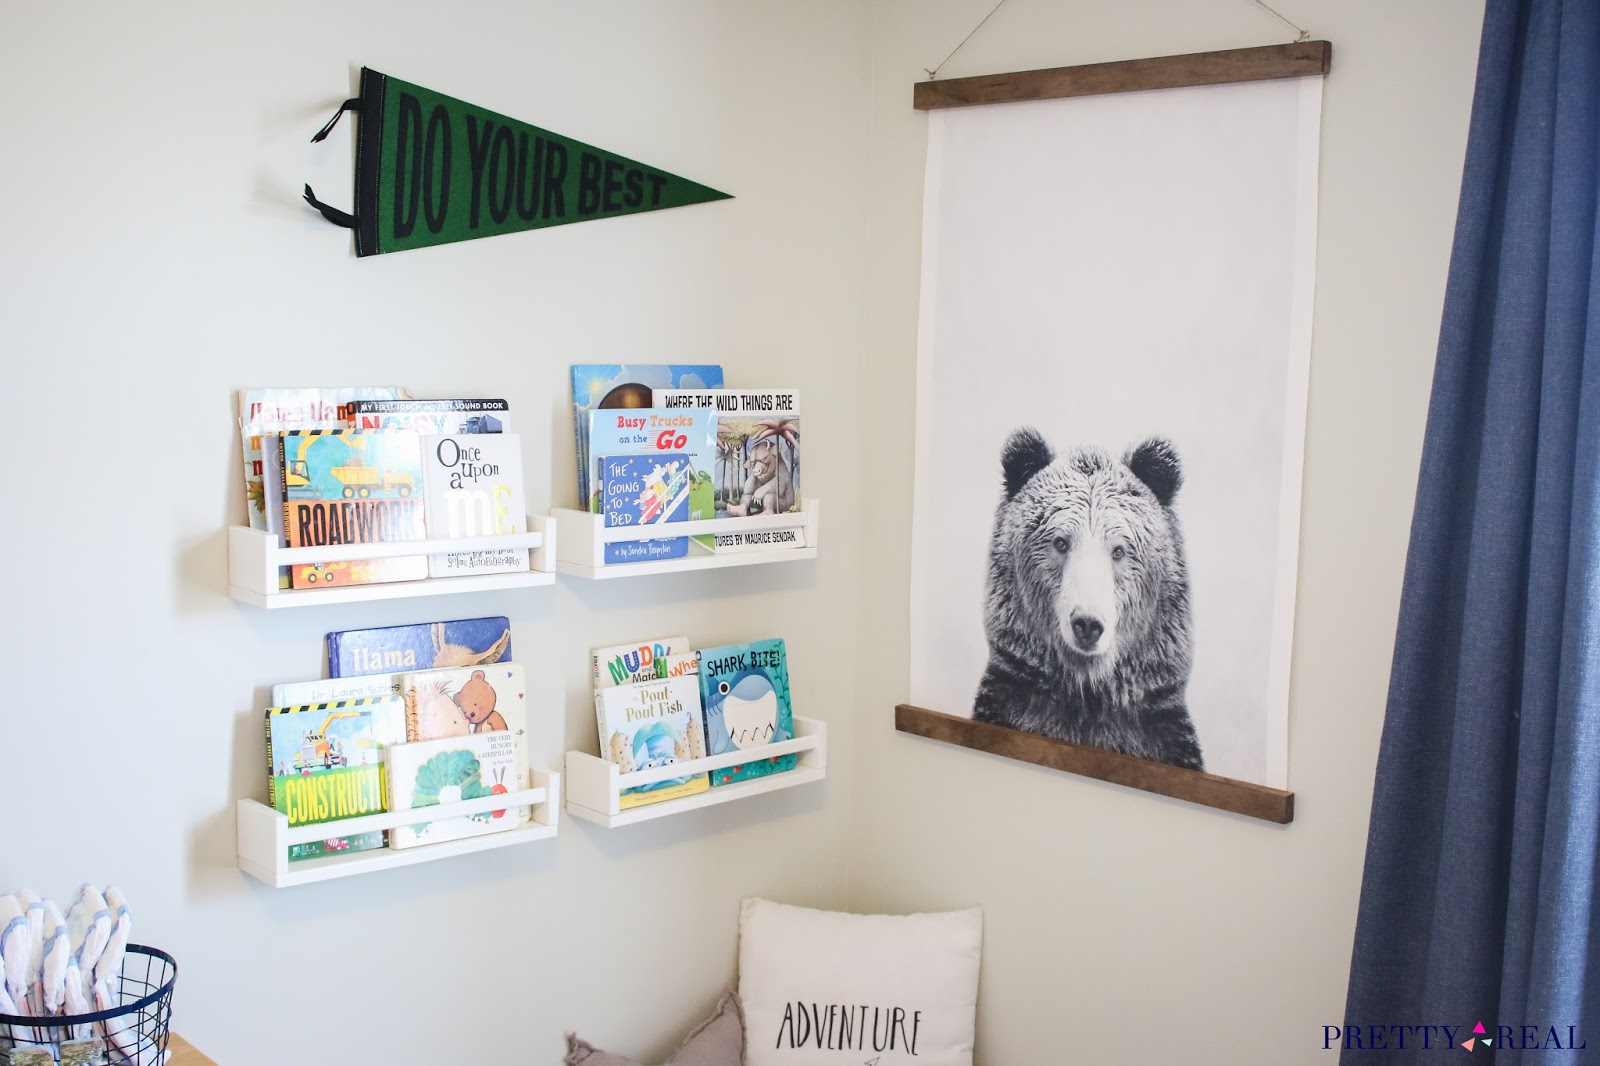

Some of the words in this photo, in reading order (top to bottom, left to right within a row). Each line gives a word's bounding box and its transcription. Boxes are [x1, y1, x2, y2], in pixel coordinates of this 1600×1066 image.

[394, 92, 451, 240] DO
[465, 114, 568, 230] YOUR
[578, 152, 668, 216] BEST
[361, 404, 373, 413] MY
[375, 403, 394, 412] FIRST
[455, 401, 481, 411] SOUND
[483, 402, 504, 410] BOOK
[666, 395, 693, 408] WHERE
[696, 395, 713, 408] THE
[716, 395, 738, 411] WILD
[741, 395, 773, 411] THINGS
[776, 394, 792, 410] ARE
[617, 415, 647, 431] Busy
[650, 415, 693, 427] Trucks
[633, 434, 648, 443] the
[656, 429, 688, 450] Go
[437, 438, 481, 468] Once
[461, 463, 499, 483] upon
[609, 462, 629, 477] THE
[450, 472, 464, 489] a
[608, 480, 640, 496] GOING
[610, 497, 623, 510] TO
[298, 500, 416, 547] ROADWORK
[609, 512, 632, 527] BED
[714, 535, 734, 547] TURES
[734, 534, 743, 546] BY
[744, 533, 771, 545] MAURICE
[772, 531, 796, 543] SENDAK
[620, 547, 628, 559] by
[628, 544, 647, 555] Sandra
[648, 543, 671, 558] Boynton
[353, 648, 416, 672] llama
[608, 643, 672, 686] MUDD
[669, 659, 698, 677] Whe
[707, 653, 747, 678] SHARK
[750, 650, 780, 669] BITE!
[632, 672, 657, 683] Matc
[332, 687, 363, 698] Laura
[367, 683, 400, 694] Schles
[640, 686, 673, 705] Pout-
[625, 704, 655, 723] Pout
[659, 700, 683, 716] Fish
[776, 1001, 921, 1056] ADVENTURE
